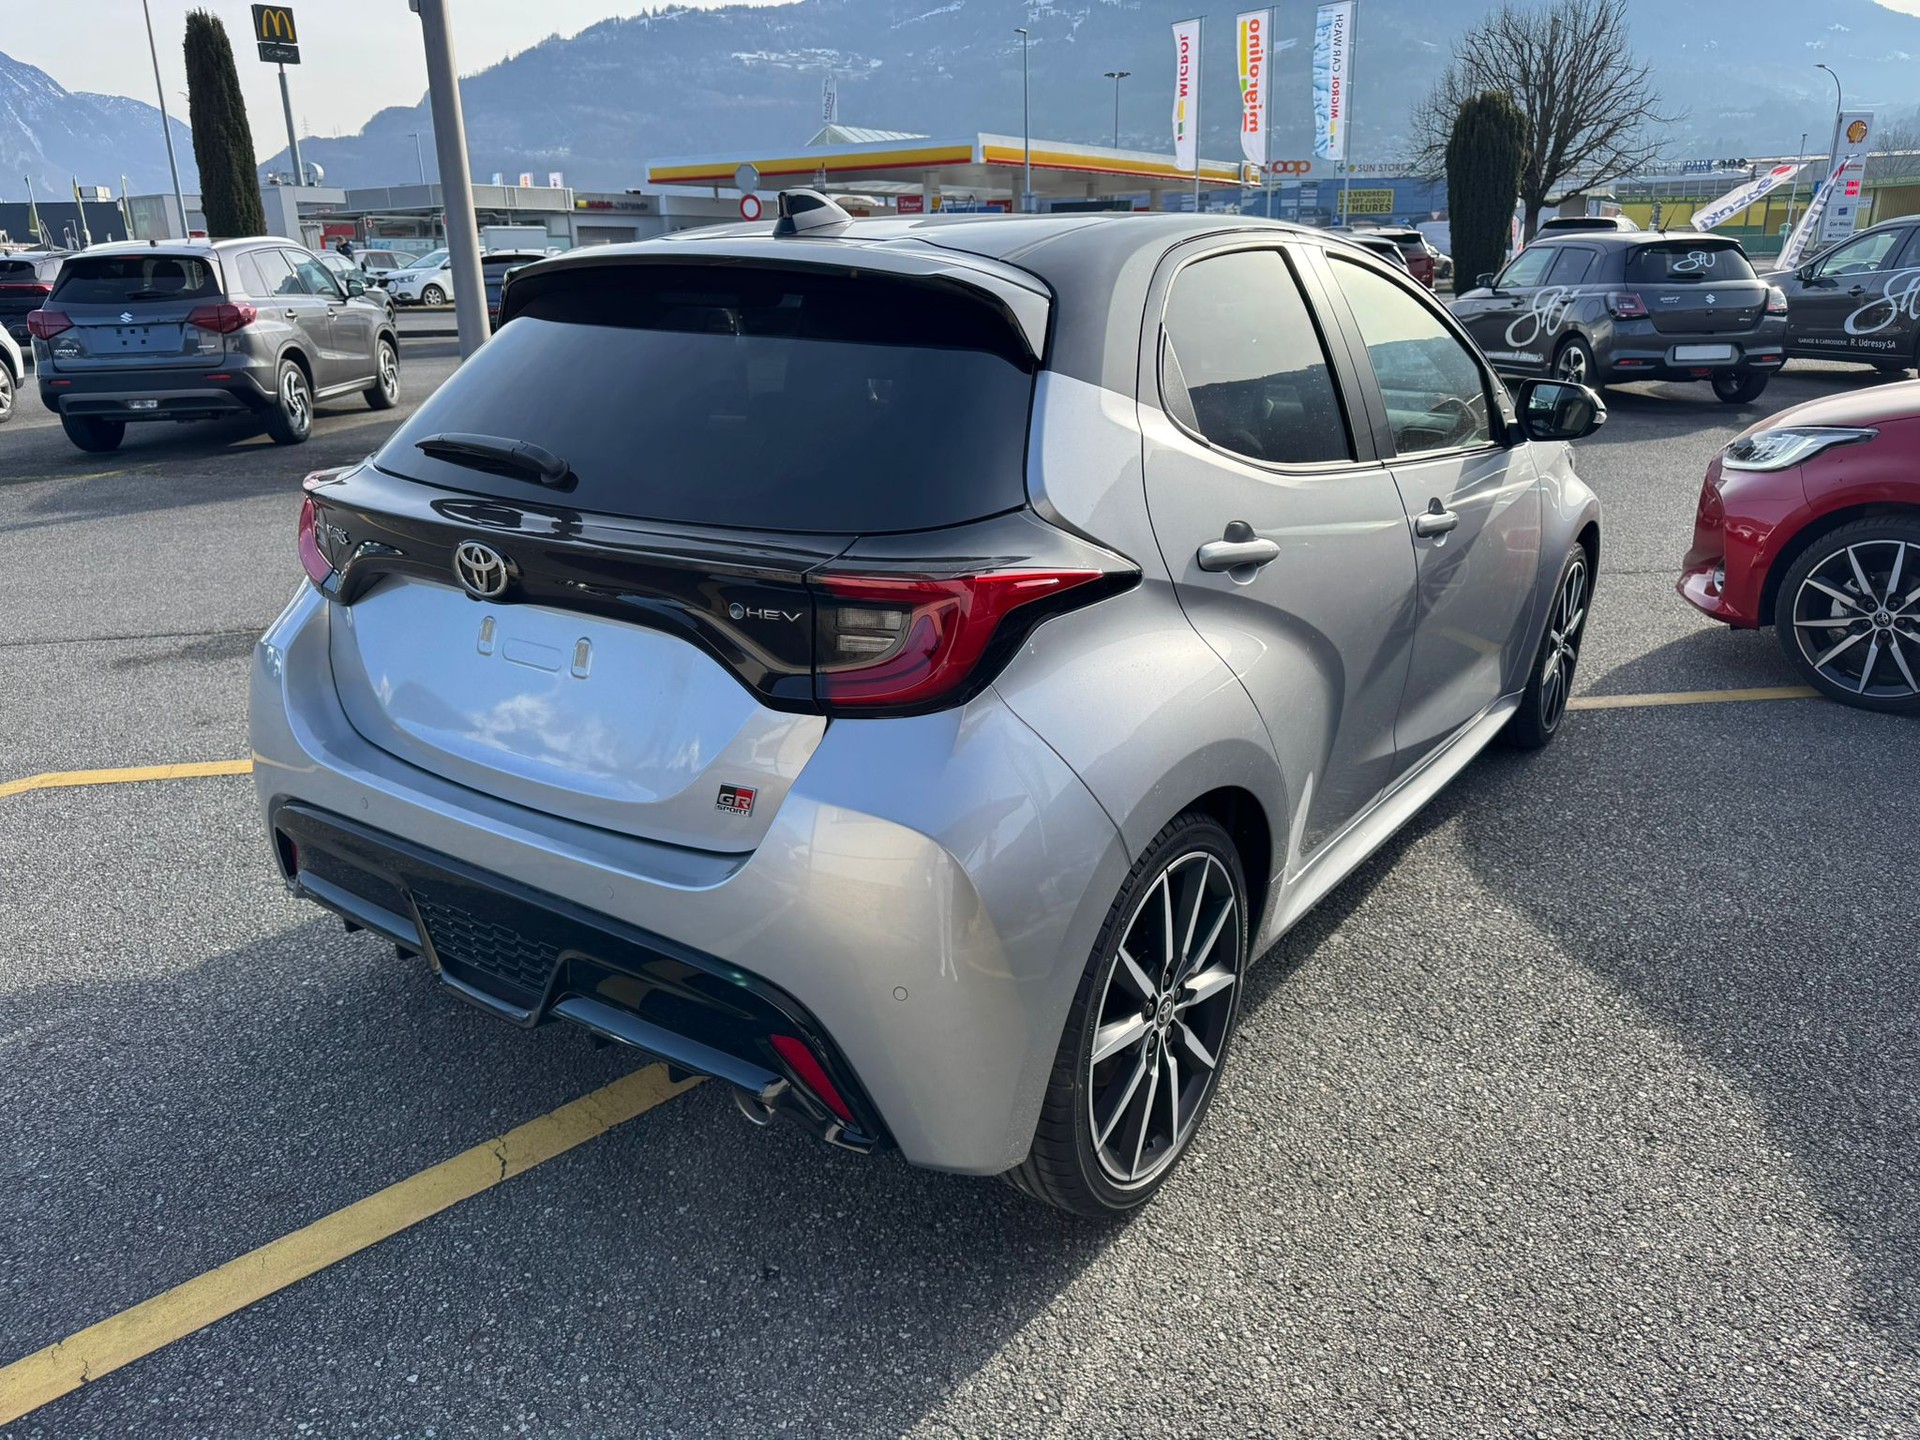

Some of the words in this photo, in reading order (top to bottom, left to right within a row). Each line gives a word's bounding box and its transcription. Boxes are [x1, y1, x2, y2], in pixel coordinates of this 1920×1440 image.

[1358, 164, 1375, 173] SUN
[1351, 203, 1392, 213] HEURES
[1859, 338, 1886, 349] Udressy
[1887, 341, 1896, 349] SA
[746, 606, 803, 622] HEV
[718, 793, 751, 808] GR
[716, 804, 750, 816] SPORT
